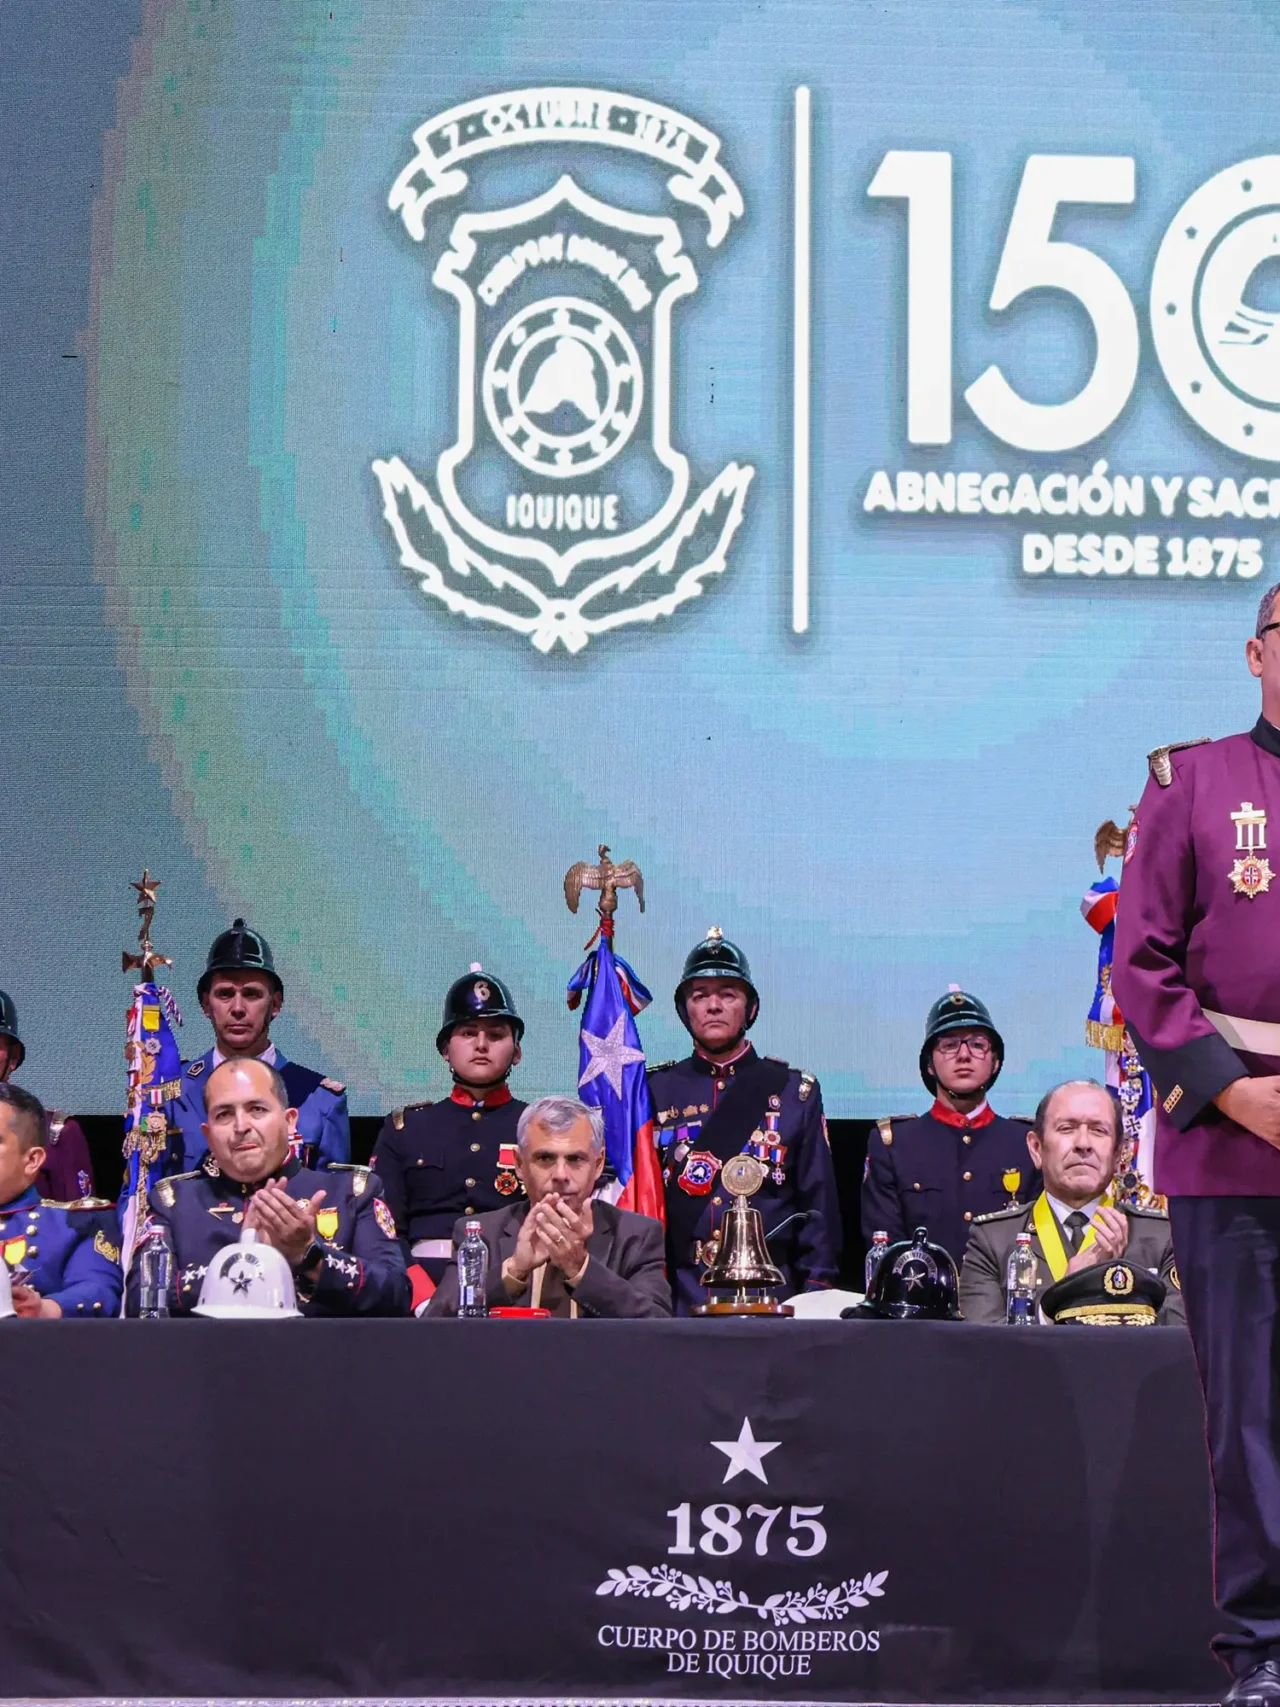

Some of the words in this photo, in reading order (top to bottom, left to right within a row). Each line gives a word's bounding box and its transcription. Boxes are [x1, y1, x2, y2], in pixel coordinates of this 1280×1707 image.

[863, 459, 1145, 516] ABNEGACIÓN
[1150, 475, 1186, 517] Y
[506, 493, 620, 531] IQUIQUE
[1022, 532, 1162, 576] DESDE
[1164, 535, 1264, 579] 1875
[473, 980, 490, 1001] 6
[667, 1502, 828, 1557] 1875
[598, 1624, 697, 1651] CUERPO
[703, 1629, 736, 1651] DE
[743, 1629, 881, 1652] BOMBEROS
[666, 1652, 700, 1673] DE
[706, 1653, 812, 1681] IQUIQUE
